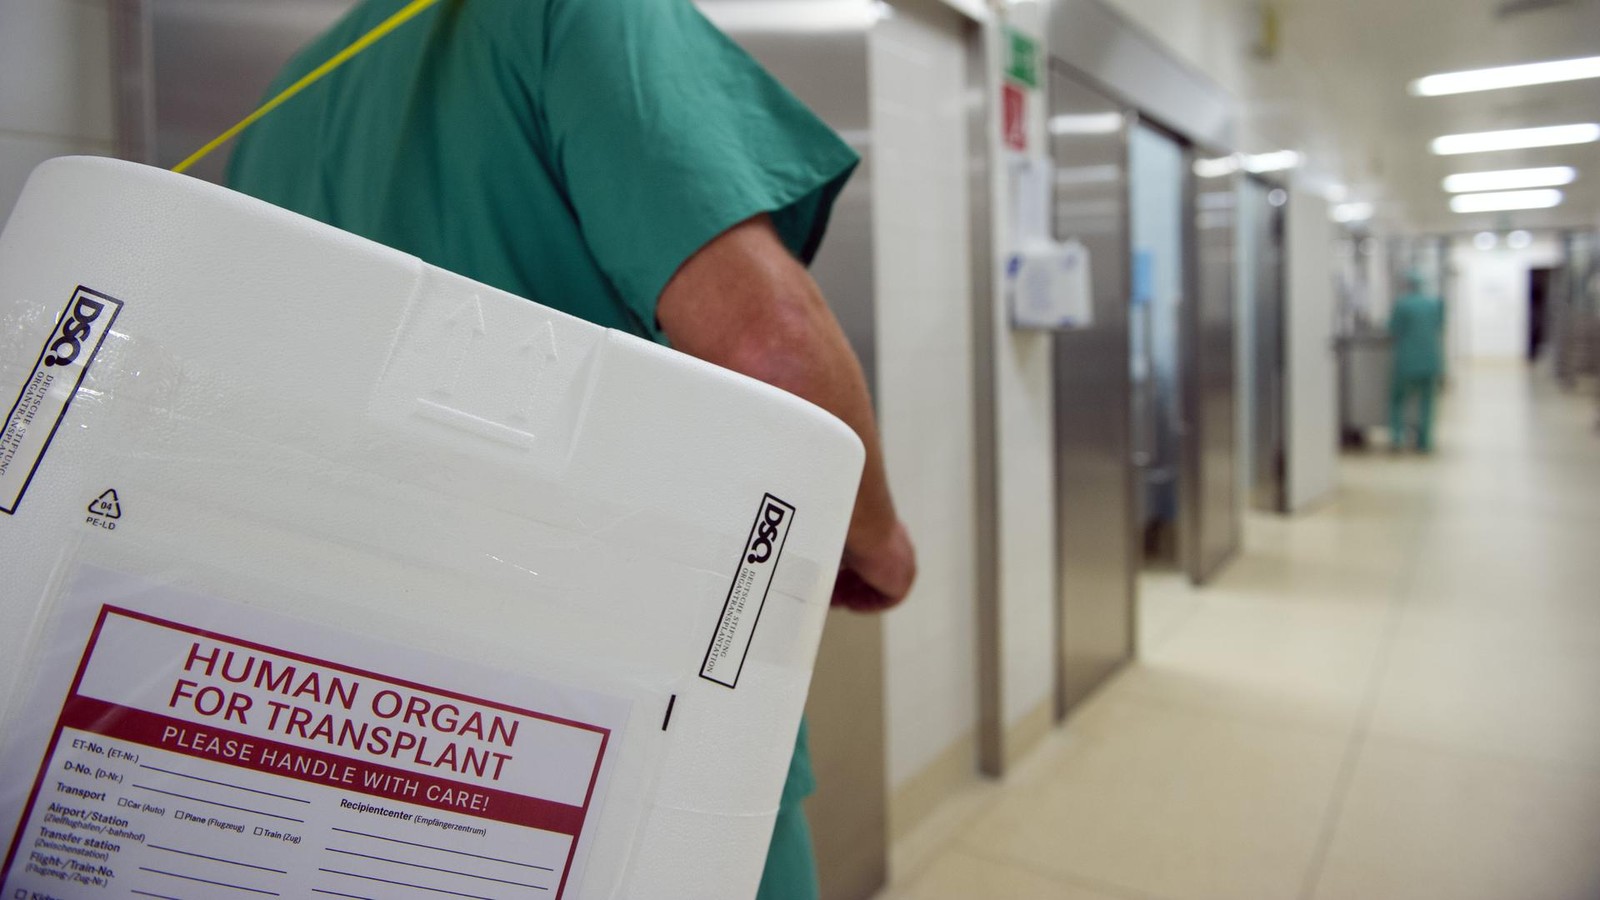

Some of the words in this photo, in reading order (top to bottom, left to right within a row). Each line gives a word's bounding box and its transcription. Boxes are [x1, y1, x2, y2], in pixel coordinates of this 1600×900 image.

[22, 374, 54, 426] DEUTSCHE
[100, 501, 113, 511] 04
[86, 516, 116, 530] PE-LD
[736, 570, 756, 613] DEUTSCHE
[707, 567, 749, 673] ORGANTRANSPLANTATION
[720, 615, 740, 658] STIFTUNG
[184, 642, 359, 710] HUMAN
[371, 689, 519, 748] ORGAN
[169, 678, 253, 725] FOR
[267, 701, 513, 781] TRANSPLANT
[72, 738, 105, 755] ET-No.
[107, 747, 139, 763] (ET-Nr.)
[64, 760, 92, 776] D-No.
[95, 768, 124, 784] (D-Nr.)
[162, 726, 254, 761] PLEASE
[260, 748, 357, 784] HANDLE
[363, 771, 420, 797] WITH
[426, 785, 490, 812] CARE!
[56, 782, 106, 802] Transport
[48, 802, 129, 828] Airport/Station
[127, 800, 141, 810] Car
[142, 803, 166, 817] (Auto)
[340, 798, 414, 821] Recipientcenter
[413, 815, 487, 838] (Empfängerzentrum)
[184, 812, 206, 824] Plane
[207, 817, 245, 833] (Flugzeug)
[39, 826, 82, 845] Transfer
[83, 837, 121, 853] station
[264, 828, 282, 840] Train
[282, 832, 302, 844] (Zug)
[34, 838, 110, 862] (Zwischenstation)
